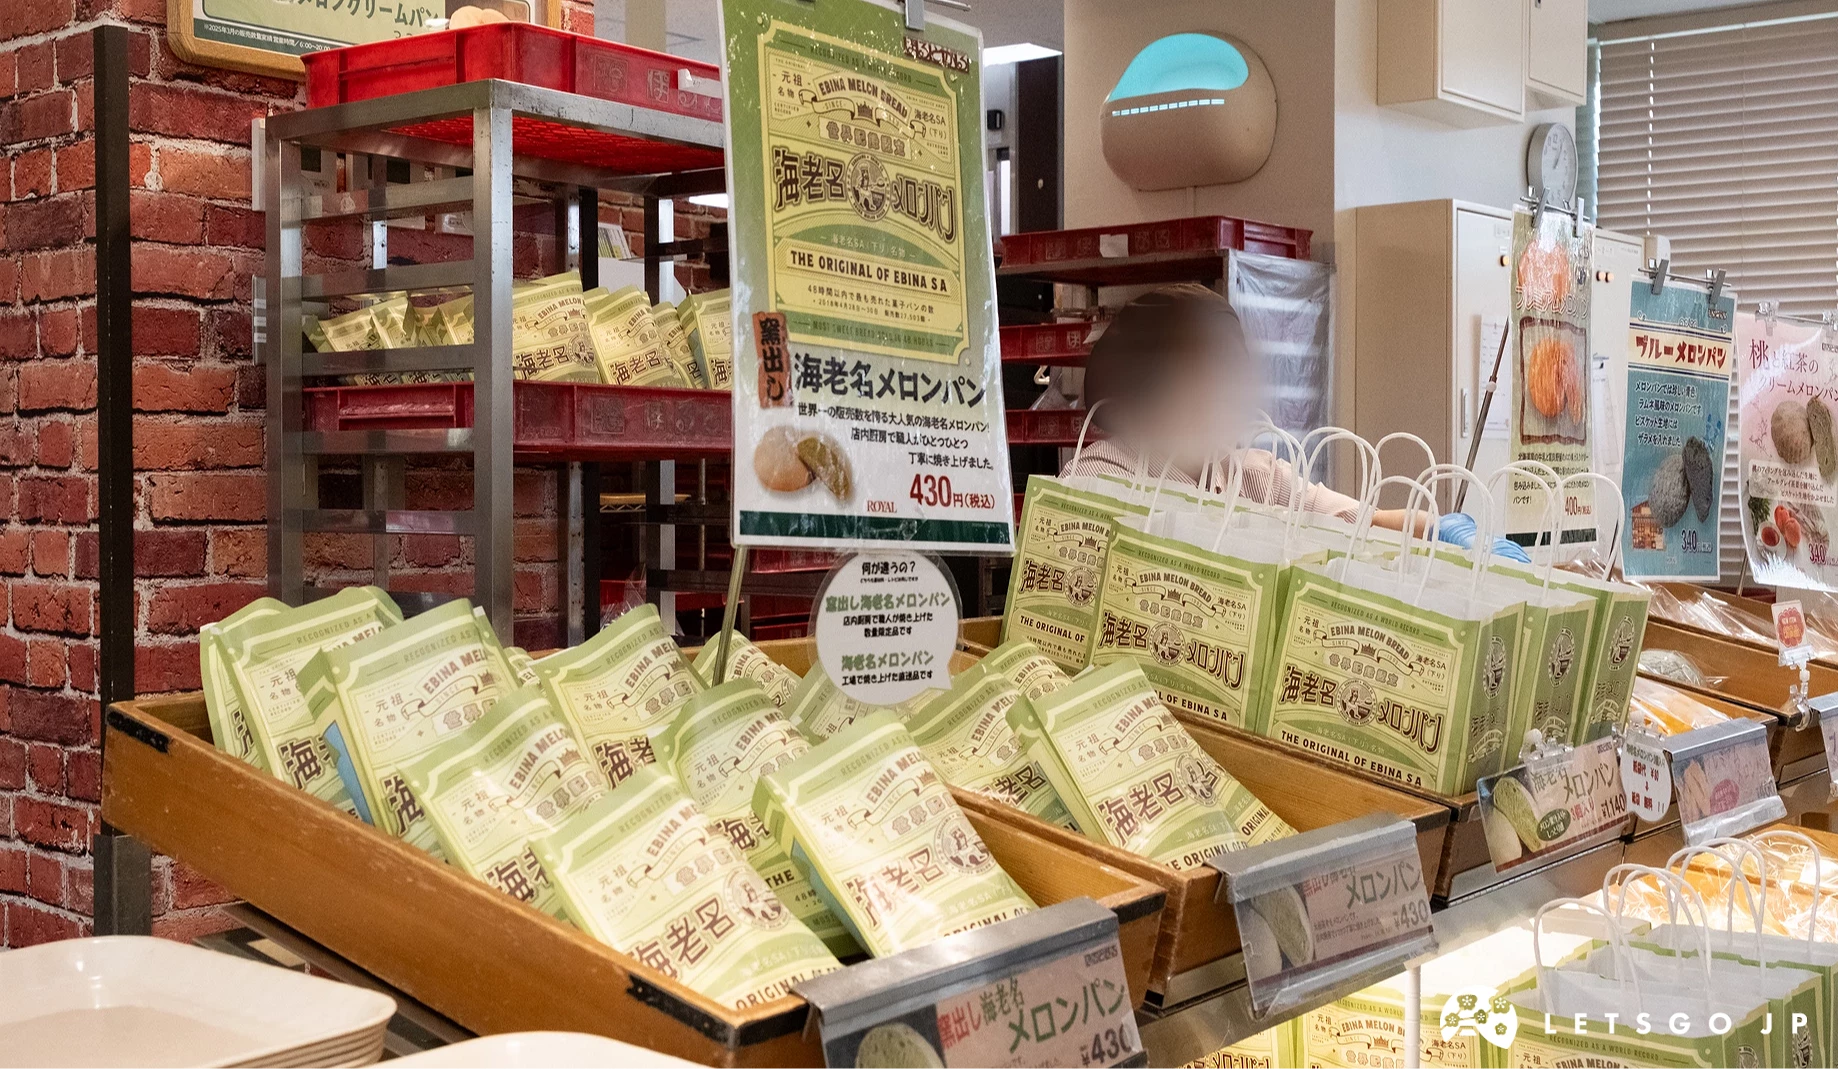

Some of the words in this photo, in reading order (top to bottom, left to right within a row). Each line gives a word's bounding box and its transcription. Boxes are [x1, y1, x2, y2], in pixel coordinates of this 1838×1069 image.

[777, 86, 795, 98] 名物
[781, 71, 802, 87] 元祖
[818, 76, 846, 96] EBINA
[847, 78, 878, 98] MELON
[880, 89, 908, 119] BREAD
[824, 100, 843, 110] SINCE
[914, 108, 946, 126] 海老名SA
[929, 129, 947, 139] (下り)
[773, 148, 846, 211] 海老名
[891, 175, 956, 245] メロンパン
[790, 250, 814, 267] THE
[818, 255, 873, 279] ORIGINAL
[876, 269, 890, 281] OF
[893, 271, 928, 290] EBINA
[931, 278, 948, 293] SA
[515, 346, 569, 380] 海老名
[759, 316, 784, 401] 窯出し
[1636, 335, 1727, 369] ブルーメロンパン
[1749, 339, 1818, 374] 桃と紅茶の
[609, 349, 661, 386] 海老名
[794, 353, 985, 409] 海老名メロンパン
[1635, 415, 1678, 429] ビスケット生地には
[851, 427, 968, 449] 店内厨房で職人がひとつひとつ
[908, 451, 994, 471] 丁寧に焼き上げました。
[867, 500, 897, 514] ROYAL
[1060, 522, 1081, 532] EBINA
[1082, 522, 1105, 536] MELON
[1018, 558, 1066, 594] 海老名
[1139, 573, 1162, 583] EBINA
[1163, 573, 1189, 588] MELON
[1189, 581, 1212, 603] BREAD
[825, 592, 951, 613] 窯出し海老名メロンパン
[1331, 602, 1364, 618] RECOGNIZED
[1366, 611, 1373, 619] AS
[296, 621, 349, 645] RECOGNIZED
[353, 618, 364, 628] AS
[843, 612, 933, 626] 店内厨房で職人が焼き上げた
[864, 626, 912, 638] 数量限定品です
[1020, 616, 1034, 627] THE
[1036, 619, 1073, 640] ORIGINAL
[1075, 632, 1086, 644] OF
[1303, 615, 1319, 629] 元祖
[403, 636, 457, 664] RECOGNIZED
[459, 630, 471, 641] AS
[605, 634, 649, 665] RECOGNIZED
[1099, 610, 1150, 650] 海老名
[1186, 639, 1246, 689] メロンパン
[1330, 625, 1355, 636] EBINA
[1357, 626, 1386, 642] MELON
[1386, 638, 1410, 661] BREAD
[624, 658, 653, 689] EBINA
[841, 651, 934, 672] 海老名メロンパン
[1015, 660, 1038, 684] EBINA
[1415, 654, 1446, 670] 海老名SA
[269, 667, 297, 687] 元祖
[423, 662, 460, 695] EBINA
[842, 670, 933, 686] 工場で焼き上げた直送品です
[268, 685, 292, 701] 名物
[375, 693, 405, 713] 元祖
[583, 690, 609, 702] 元祖
[583, 701, 603, 711] 名物
[1092, 684, 1132, 709] RECOGNIZED
[1166, 694, 1178, 704] OF
[1182, 699, 1210, 714] EBINA
[373, 713, 397, 728] 名物
[711, 703, 758, 728] RECOGNIZED
[947, 694, 984, 726] RECOGNIZED
[1116, 703, 1144, 734] EBINA
[1280, 664, 1338, 708] 海老名
[1377, 699, 1445, 754] メロンパン
[735, 720, 766, 752] EBINA
[970, 712, 997, 743] EBINA
[483, 726, 528, 763] RECOGNIZED
[1076, 734, 1100, 750] 元祖
[1281, 730, 1299, 745] THE
[1303, 738, 1350, 763] ORIGINAL
[1354, 756, 1367, 767] OF
[1370, 762, 1402, 780] EBINA
[509, 751, 539, 790] EBINA
[694, 753, 720, 777] 元祖
[840, 741, 890, 777] RECOGNIZED
[1077, 750, 1097, 764] 名物
[865, 761, 898, 804] EBINA
[1563, 763, 1614, 804] メロンパン
[462, 789, 490, 812] 元祖
[618, 792, 672, 834] RECOGNIZED
[1099, 772, 1185, 848] 海老名
[1570, 796, 1594, 821] 3個入り
[647, 817, 681, 858] EBINA
[1183, 843, 1231, 867] ORIGINAL
[598, 864, 628, 888] 元祖
[846, 847, 944, 928] 海老名
[1346, 861, 1420, 909] メロンパン
[1394, 899, 1428, 930] ¥430
[628, 897, 735, 981] 海老名
[937, 976, 1024, 1048] 窯出し海老名
[1008, 978, 1125, 1054] メロンパン
[1317, 1014, 1332, 1025] 元祖
[1341, 1020, 1364, 1033] EBINA
[1365, 1020, 1395, 1033] MELON
